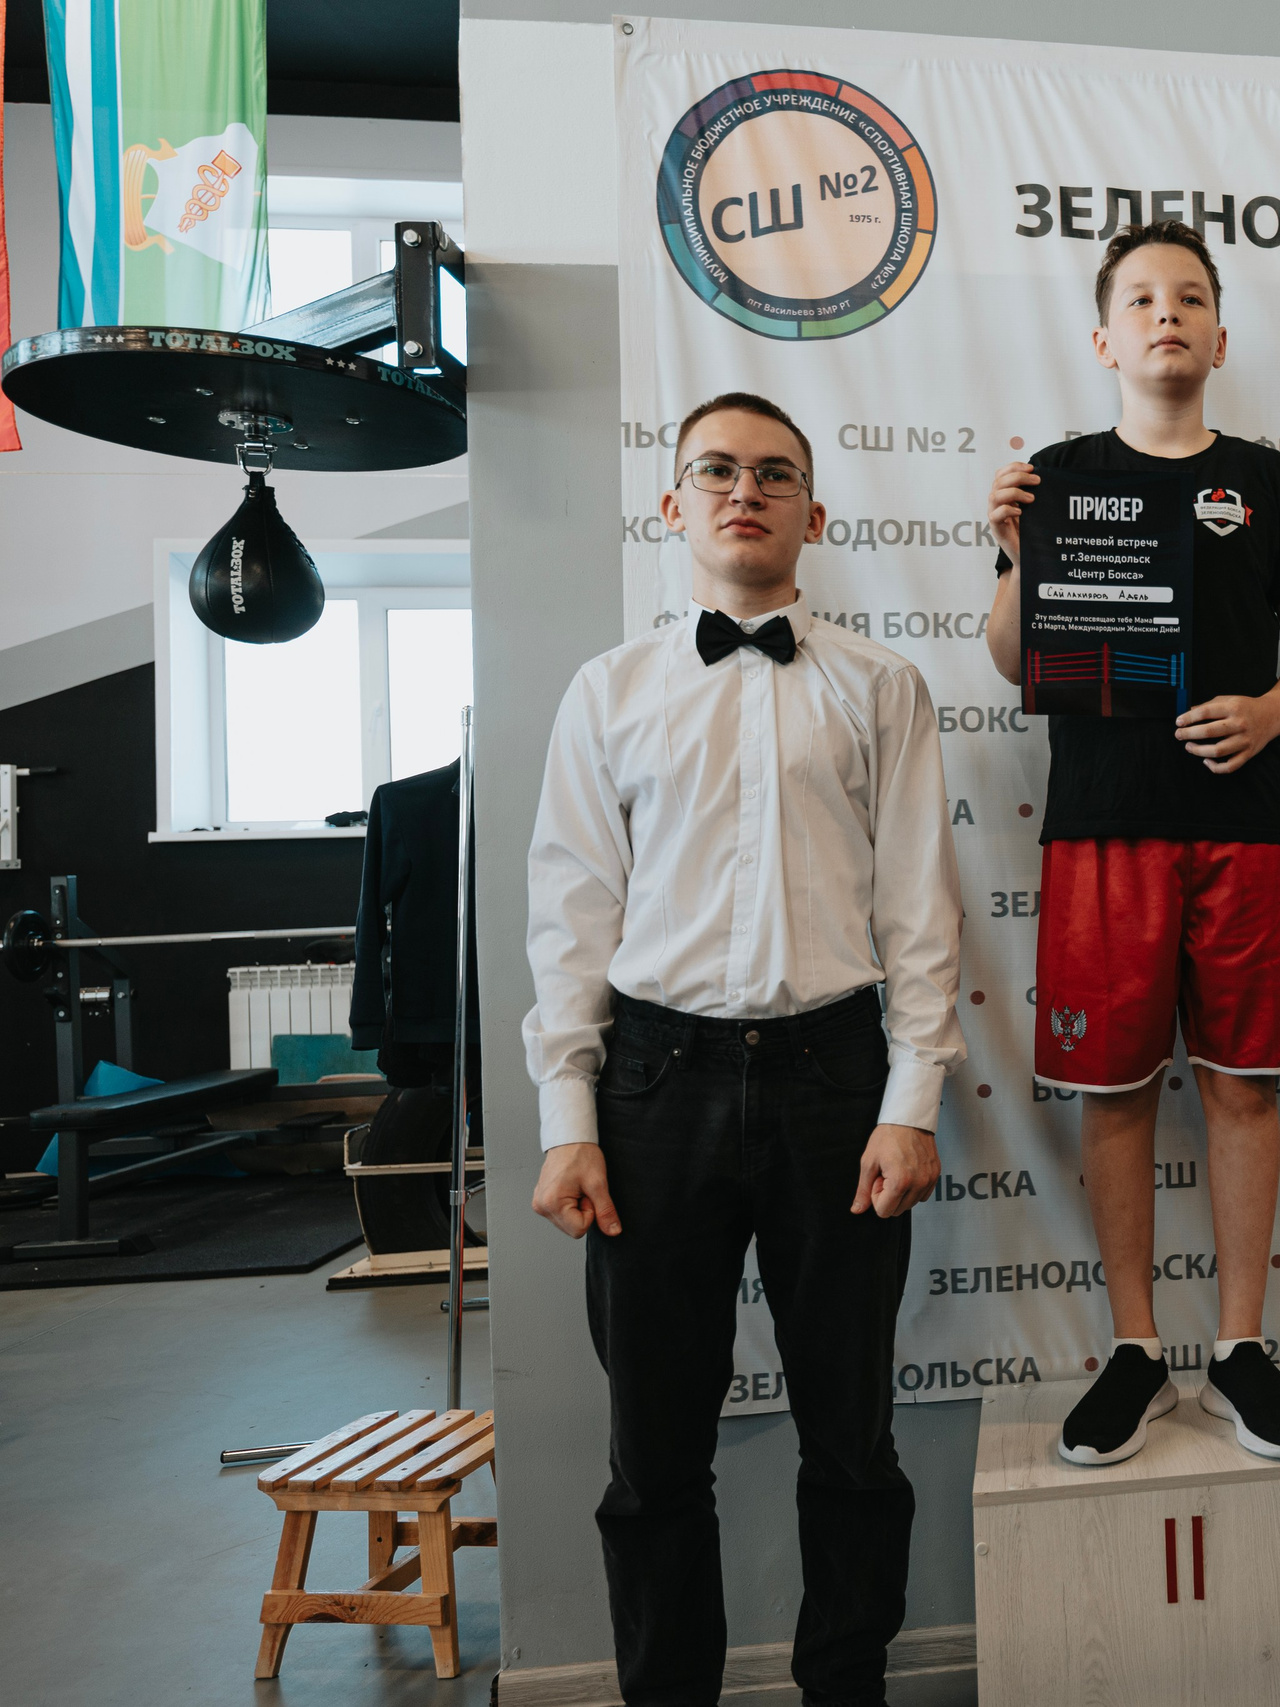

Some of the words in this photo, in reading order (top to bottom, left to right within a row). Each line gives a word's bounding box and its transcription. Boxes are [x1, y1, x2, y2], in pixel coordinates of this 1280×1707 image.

[763, 94, 858, 124] УЧРЕЖДЕНИЕ
[691, 99, 762, 160] БЮДЖЕТНОЕ
[859, 121, 912, 209] «СПОРТИВНАЯ
[711, 183, 803, 243] СШ
[819, 165, 879, 201] №2
[682, 160, 728, 283] МУНИЦИПАЛЬНОЕ
[849, 215, 872, 223] 1975
[890, 212, 912, 261] ШКОЛА
[747, 298, 762, 309] пгт
[764, 303, 815, 316] Васильево
[839, 299, 851, 311] РТ
[838, 424, 893, 452] СШ
[907, 427, 945, 452] №
[958, 427, 976, 452] 2
[1069, 496, 1144, 521] ПРИЗЕР
[804, 519, 998, 551] ОДОЛЬСК
[1056, 537, 1062, 545] в
[1065, 536, 1115, 546] матчевой
[1117, 539, 1158, 549] встрече
[1061, 553, 1067, 561] в
[1070, 552, 1150, 564] г.Зеленодольск
[1068, 568, 1105, 581] «Центр
[1108, 569, 1144, 580] Бокса»
[1035, 613, 1047, 622] Эту
[1048, 614, 1073, 623] победу
[1044, 623, 1067, 631] Марта,
[1068, 623, 1125, 632] Международным
[1127, 625, 1158, 633] Женским
[938, 706, 1029, 733] БОКС
